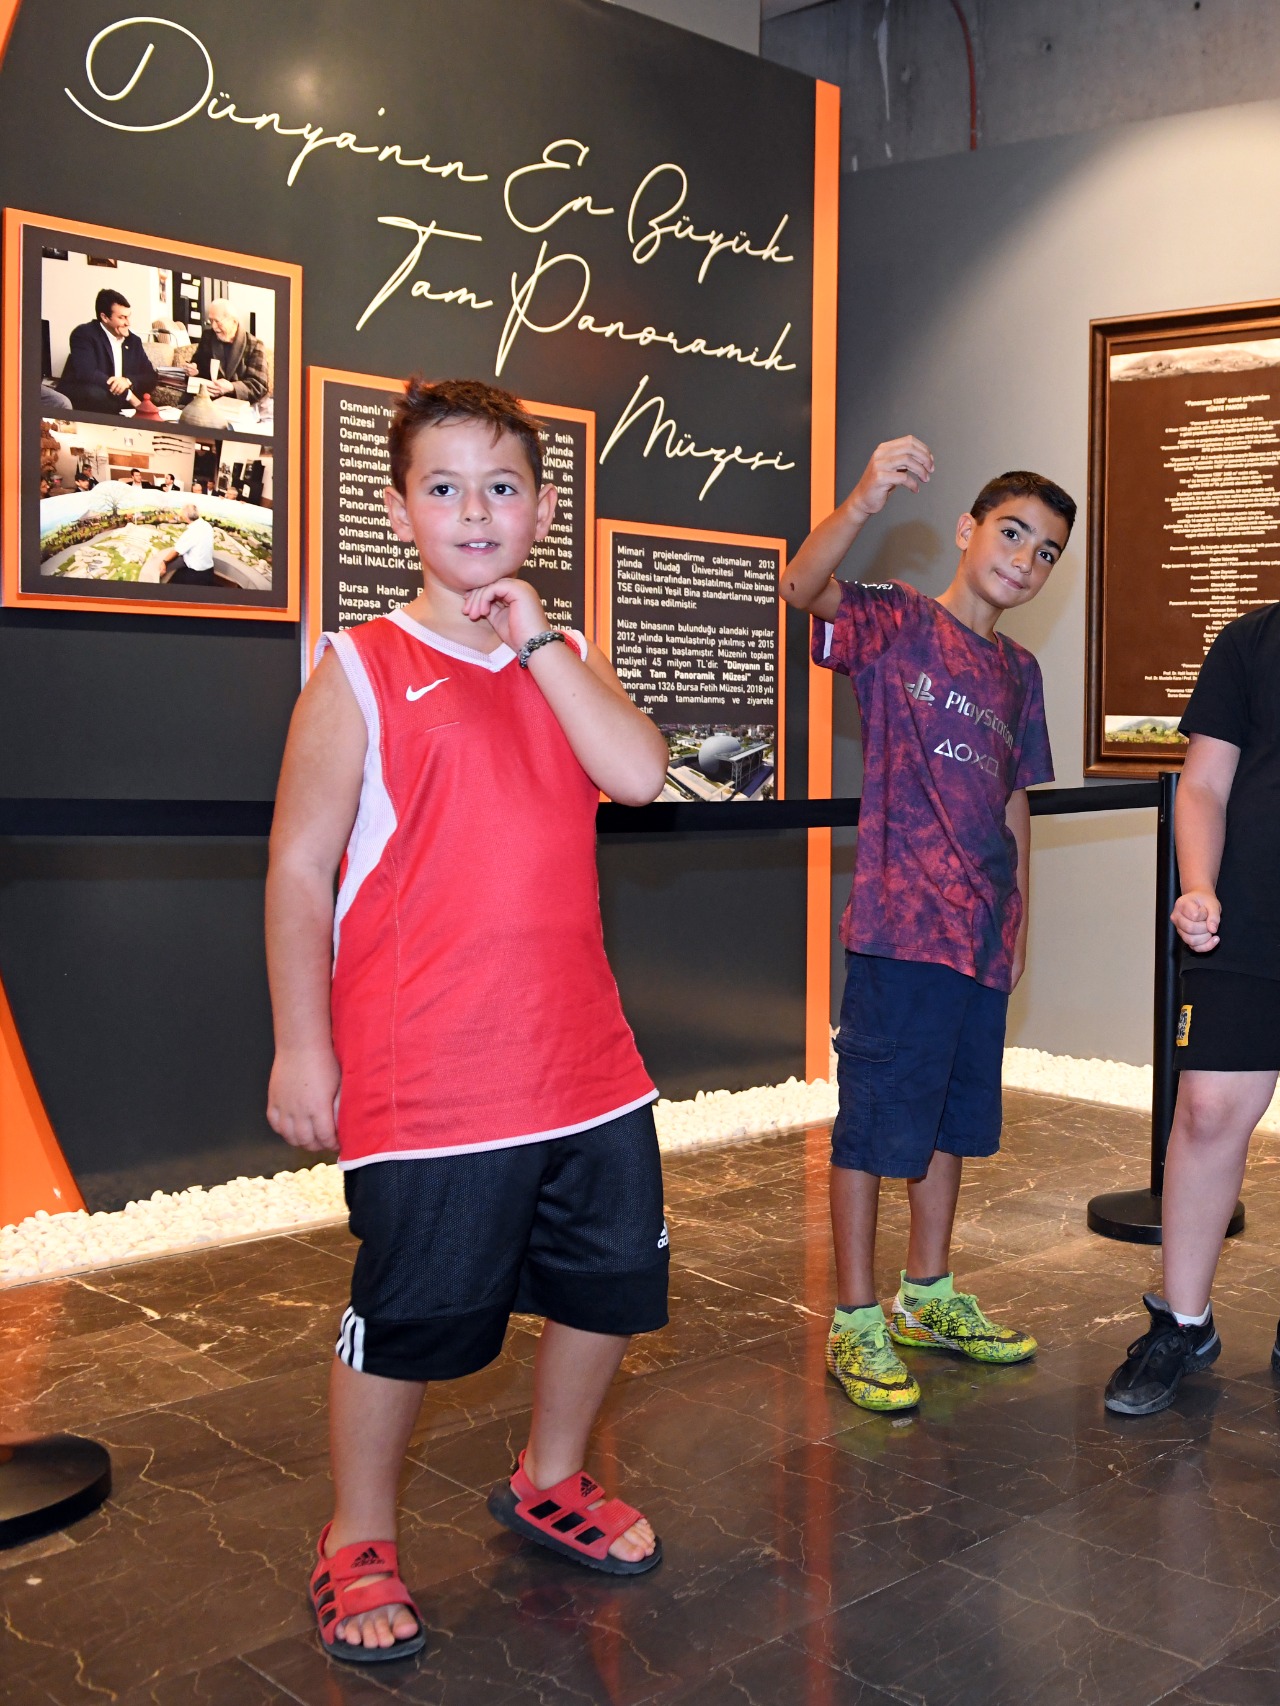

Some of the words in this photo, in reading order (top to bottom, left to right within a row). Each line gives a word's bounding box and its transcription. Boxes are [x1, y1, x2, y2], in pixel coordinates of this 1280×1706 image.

[64, 16, 489, 186] Dünya'nın
[504, 139, 615, 233] En
[627, 163, 795, 285] Büyük
[356, 216, 494, 331] Tam
[495, 241, 797, 376] Panoramik
[340, 416, 374, 428] müzesi
[546, 446, 573, 457] yılında
[555, 433, 573, 444] fetih
[600, 375, 796, 502] Müzesi
[340, 443, 389, 457] tarafından
[563, 473, 572, 482] ön
[340, 472, 391, 485] panoramik
[558, 498, 572, 507] çok
[340, 484, 363, 496] daha
[563, 512, 572, 520] ve
[339, 514, 391, 526] sonucunda
[339, 526, 384, 539] olmasına
[558, 547, 572, 557] baş
[339, 540, 400, 556] danışmanlığı
[540, 559, 557, 568] Prof.
[561, 561, 572, 570] Dr.
[340, 554, 362, 565] Halil
[365, 555, 405, 568] İNALCIK
[618, 545, 644, 556] Mimari
[653, 550, 705, 562] projelendirme
[712, 556, 751, 566] çalışmaları
[759, 560, 774, 569] 2013
[617, 558, 642, 568] yılında
[654, 561, 680, 574] Uludağ
[692, 564, 733, 576] Üniversitesi
[744, 570, 774, 580] Mimarlık
[618, 570, 652, 581] Fakültesi
[654, 574, 691, 584] tarafından
[693, 577, 733, 589] başlatılmış,
[735, 581, 753, 590] müze
[754, 582, 774, 592] binası
[339, 582, 368, 593] Bursa
[377, 585, 409, 596] Hanlar
[554, 598, 572, 607] Hacı
[617, 582, 632, 592] TSE
[635, 584, 662, 594] Güvenli
[665, 586, 682, 596] Yeşil
[684, 588, 700, 597] Bina
[703, 590, 752, 601] standartlarına
[754, 596, 774, 604] uygun
[617, 595, 642, 605] olarak
[644, 597, 659, 606] inşa
[661, 598, 697, 609] edilmiştir.
[617, 619, 637, 629] Müze
[641, 621, 674, 631] binasının
[678, 623, 716, 635] bulunduğu
[719, 626, 748, 635] alandaki
[752, 629, 774, 637] yapılar
[617, 631, 635, 641] 2012
[638, 633, 662, 642] yılında
[666, 634, 715, 646] kamulaştırılıp
[718, 638, 745, 647] yıkılmış
[758, 640, 774, 648] 2015
[617, 644, 642, 654] yılında
[646, 645, 668, 655] inşası
[672, 647, 713, 657] başlamıştır.
[718, 649, 747, 658] Müzenin
[751, 651, 774, 660] toplam
[617, 656, 647, 666] maliyeti
[652, 658, 661, 666] 45
[667, 659, 691, 668] milyon
[697, 659, 718, 668] TL'dir.
[724, 660, 760, 671] "Dünyanın
[765, 663, 774, 671] En
[616, 668, 642, 679] Büyük
[650, 669, 666, 678] Tam
[675, 670, 715, 680] Panoramik
[723, 672, 751, 681] Müzesi"
[759, 674, 773, 682] olan
[619, 680, 656, 690] anorama
[658, 682, 675, 690] 1326
[677, 682, 698, 691] Bursa
[700, 683, 717, 691] Fetih
[719, 684, 745, 693] Müzesi,
[747, 685, 763, 693] 2018
[764, 686, 773, 694] yılı
[644, 694, 668, 704] ayında
[676, 695, 725, 704] tamamlanmış
[747, 696, 773, 706] ziyarete
[945, 690, 1014, 750] PlayStation
